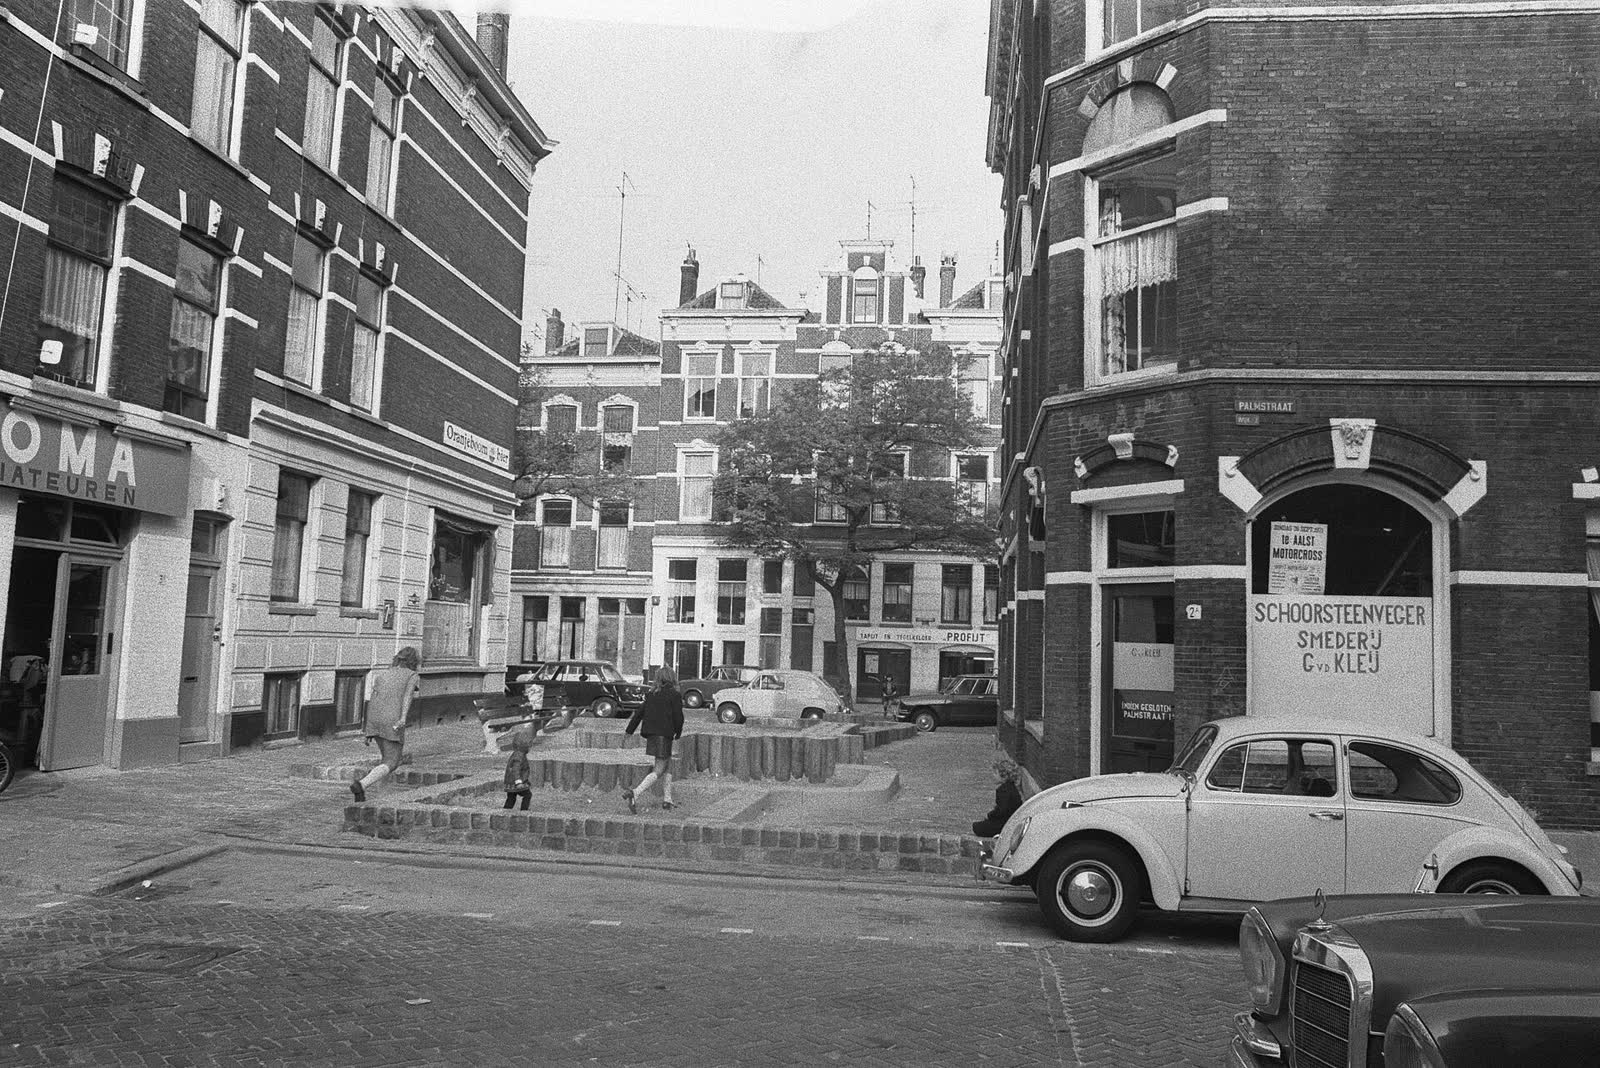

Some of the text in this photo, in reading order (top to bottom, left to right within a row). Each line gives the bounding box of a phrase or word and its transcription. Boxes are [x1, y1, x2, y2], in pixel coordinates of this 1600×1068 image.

[1238, 402, 1293, 411] PALMSTRAAT
[446, 425, 488, 456] Oranjeboom
[1282, 535, 1315, 546] te AALST
[1272, 547, 1323, 561] MOTORCROSS
[1254, 602, 1426, 625] SCHOORSTEENVEGER
[1140, 703, 1172, 713] GESLOTEN
[1123, 710, 1166, 720] PALMSTRAAT
